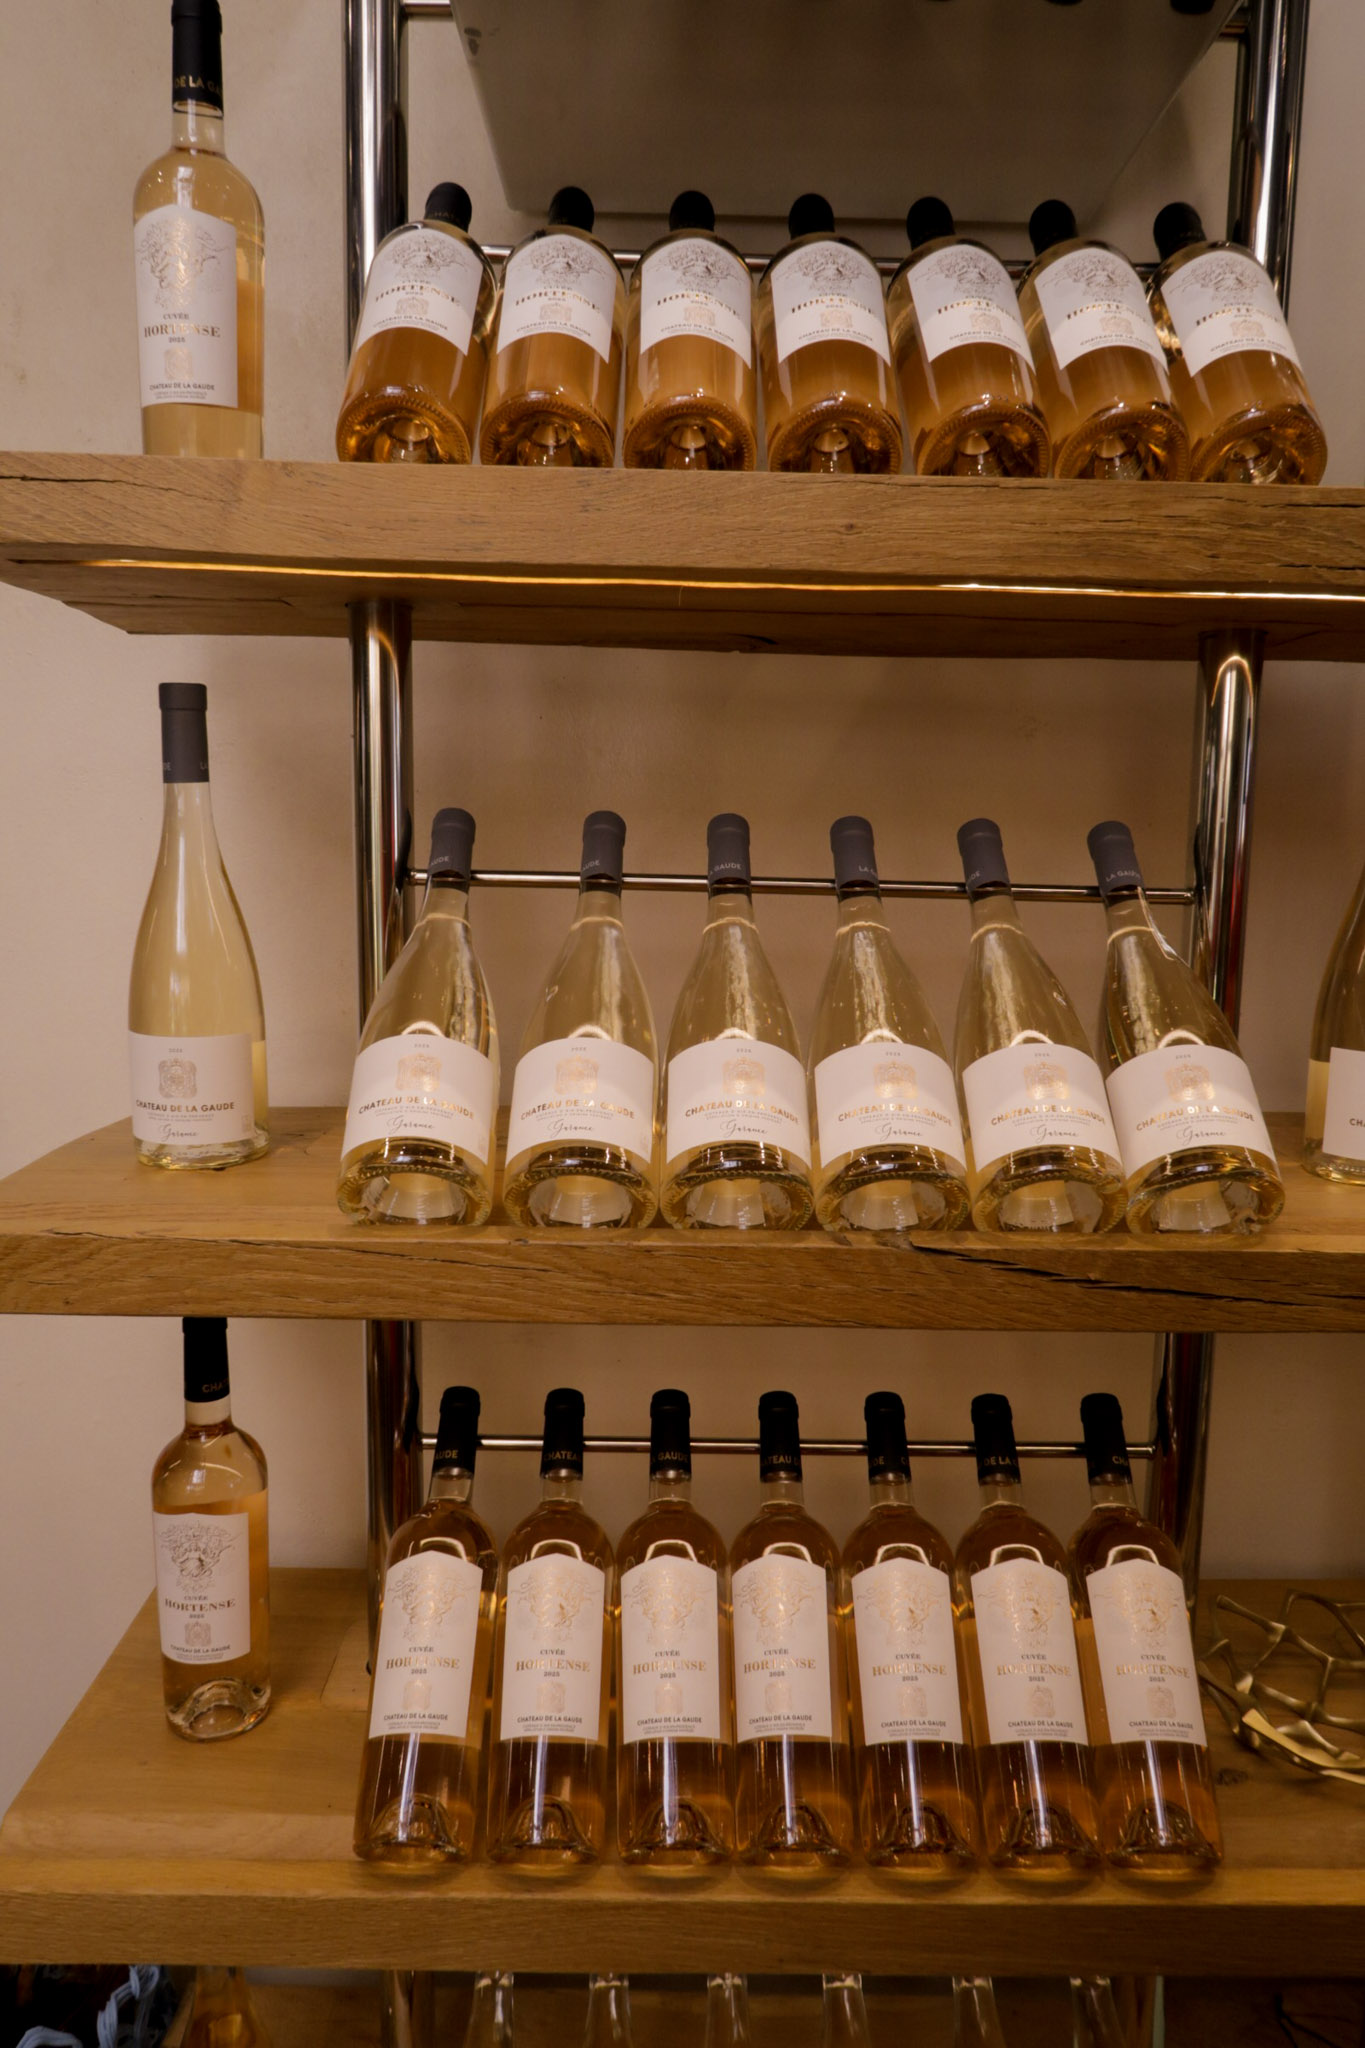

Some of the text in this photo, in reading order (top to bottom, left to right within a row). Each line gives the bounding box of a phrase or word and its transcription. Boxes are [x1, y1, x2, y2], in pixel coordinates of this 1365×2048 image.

[188, 75, 204, 88] LA
[136, 1100, 235, 1112] CHATEAU DE LA GAUDE
[358, 1096, 402, 1114] CHATEAU
[406, 1096, 419, 1104] DE
[423, 1096, 437, 1106] LA
[521, 1100, 562, 1120] CHATEAU
[565, 1099, 579, 1107] DE
[736, 1099, 750, 1108] DE
[754, 1100, 766, 1110] LA
[889, 1103, 904, 1111] DE
[907, 1104, 919, 1113] LA
[1043, 1104, 1056, 1112] DE
[1060, 1105, 1072, 1114] LA
[1206, 1105, 1219, 1113] LA
[999, 1456, 1011, 1465] LA
[165, 1598, 236, 1612] HORTENSE
